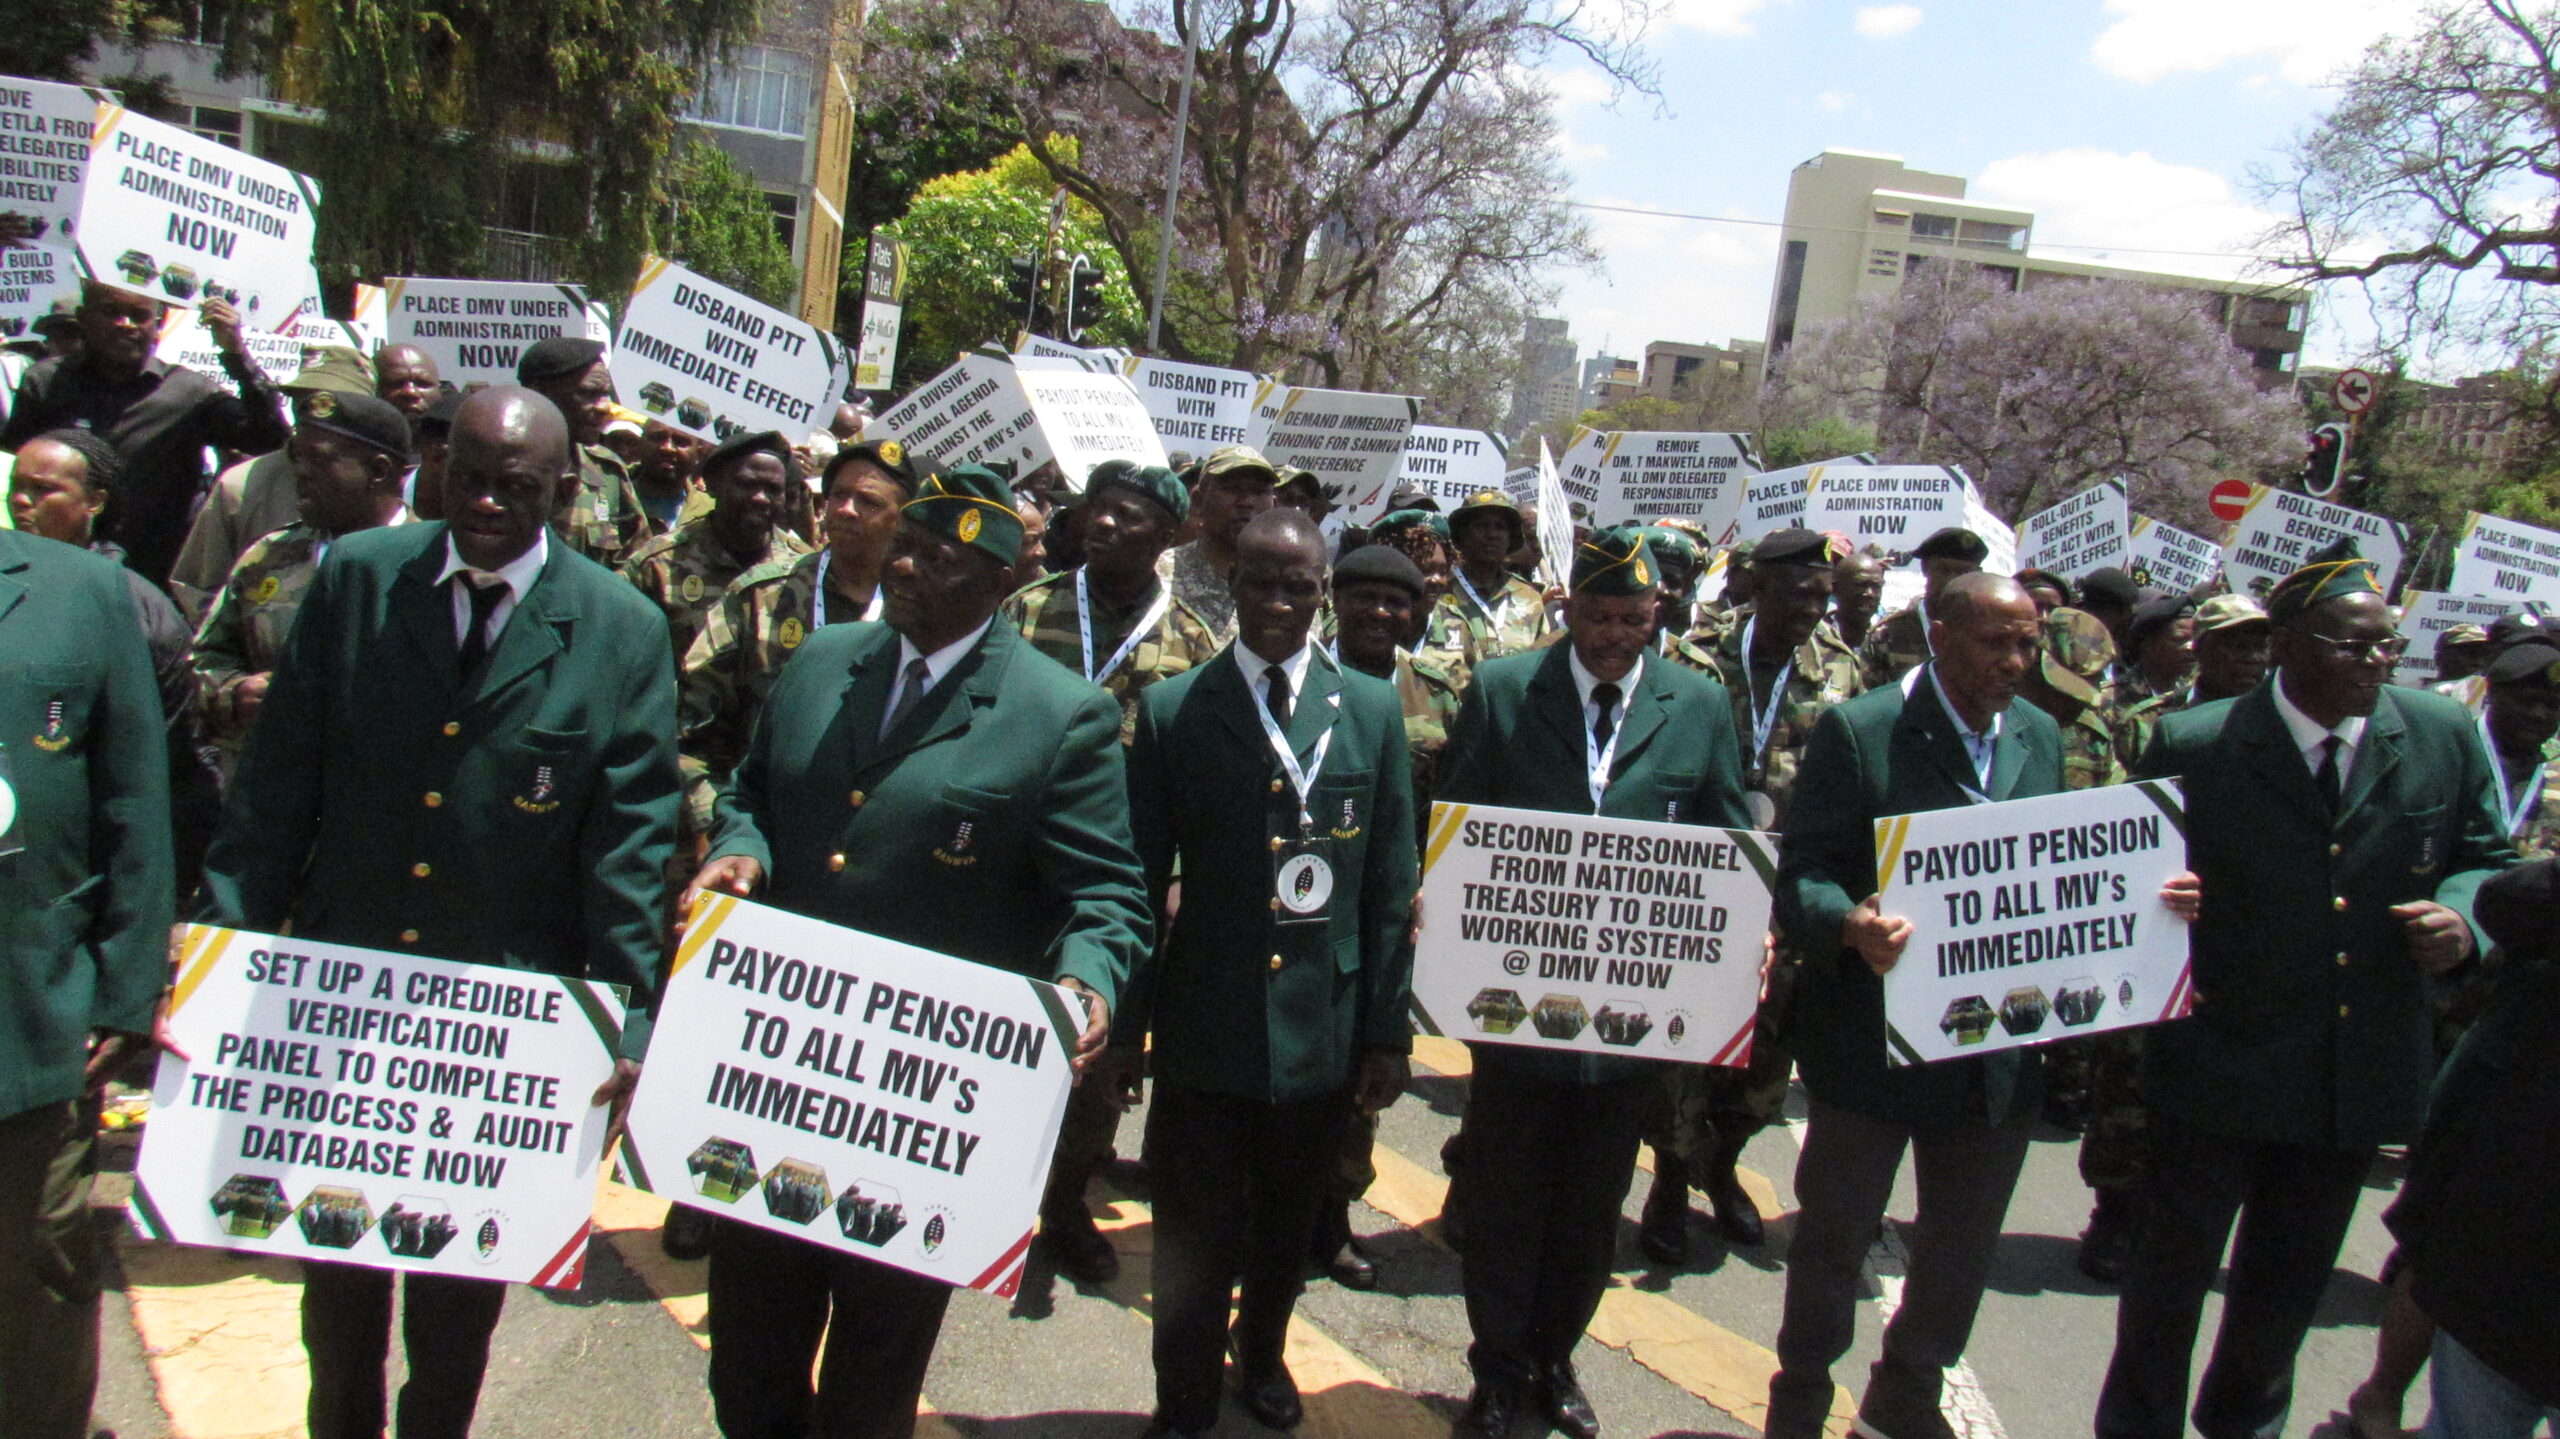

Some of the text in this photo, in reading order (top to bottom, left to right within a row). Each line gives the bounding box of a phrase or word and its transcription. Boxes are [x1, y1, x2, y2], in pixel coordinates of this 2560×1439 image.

[116, 131, 300, 214] PLACE DMV UNDER
[119, 166, 288, 240] ADMINISTRATION
[166, 212, 238, 260] NOW
[8, 252, 53, 267] BUILD
[872, 242, 892, 268] Flats
[870, 271, 891, 296] To Let
[405, 296, 569, 318] PLACE DMV UNDER
[673, 283, 765, 340] DISBAND
[767, 324, 806, 357] PTT
[414, 320, 562, 340] ADMINISTRATION
[459, 345, 519, 369] NOW
[705, 329, 759, 369] WITH
[622, 327, 741, 394] IMMEDIATE
[743, 378, 815, 424] EFFECT
[1148, 370, 1248, 398] DISBAND PTT
[887, 402, 918, 431] STOP
[919, 367, 971, 409] DIVISIVE
[950, 378, 1000, 418] AGENDA
[1177, 398, 1216, 418] WITH
[969, 409, 995, 432] THE
[1283, 411, 1407, 433] DEMAND IMMEDIATE
[967, 445, 984, 464] OF
[983, 427, 1015, 453] MV's
[1268, 432, 1322, 450] FUNDING
[1325, 436, 1349, 451] FOR
[1452, 440, 1480, 456] PTT
[1656, 440, 1700, 452] REMOVE
[1288, 455, 1367, 472] CONFERENCE
[1408, 457, 1447, 474] WITH
[1571, 464, 1586, 479] IN
[1613, 456, 1737, 469] DM. T MAKWETLA FROM
[1444, 481, 1499, 498] EFFE
[1620, 472, 1727, 484] ALL DMV DELEGATED
[1821, 479, 1950, 492] PLACE DMV UNDER
[1623, 488, 1718, 499] RESPONSIBILITIES
[1748, 485, 1787, 502] PLACE
[1825, 497, 1943, 511] ADMINISTRATION
[1633, 503, 1703, 515] IMMEDIATELY
[2032, 487, 2104, 532] ROLL-OUT ALL
[2276, 494, 2380, 536] ROLL-OUT ALL
[1859, 516, 1907, 534] NOW
[2042, 511, 2094, 545] BENEFITS
[2285, 518, 2359, 545] BENEF
[2474, 526, 2506, 546] PLACE
[2509, 535, 2533, 551] DMV
[2025, 520, 2115, 569] IN THE ACT WITH
[2082, 536, 2122, 565] EFFECT
[2155, 526, 2211, 557] ROLL-OUT
[2251, 530, 2271, 548] IN
[2273, 536, 2303, 557] THE
[2151, 561, 2172, 580] THE
[2173, 571, 2198, 589] ACT
[2160, 547, 2214, 577] BENEFITS
[2474, 546, 2560, 578] ADMINISTRATION
[2494, 569, 2532, 594] NOW
[2437, 599, 2465, 613] STOP
[1462, 820, 1742, 872] SECOND PERSONNEL
[1903, 815, 2161, 886] PAYOUT PENSION
[1489, 854, 1706, 899] FROM NATIONAL
[1462, 883, 1728, 932] TREASURY TO BUILD
[1944, 870, 2127, 928] TO ALL MV's
[1461, 914, 1722, 964] WORKING SYSTEMS
[1937, 913, 2137, 978] IMMEDIATELY
[1502, 950, 1674, 989] @ DMV NOW
[246, 949, 563, 1025] SET UP A CREDIBLE
[705, 939, 1048, 1070] PAYOUT PENSION
[287, 998, 510, 1059] VERIFICATION
[215, 1033, 560, 1110] PANEL TO COMPLETE
[740, 1008, 980, 1114] TO ALL MV's
[190, 1072, 573, 1155] THE PROCESS & AUDIT
[705, 1062, 981, 1178] IMMEDIATELY
[240, 1124, 507, 1189] DATABASE NOW
